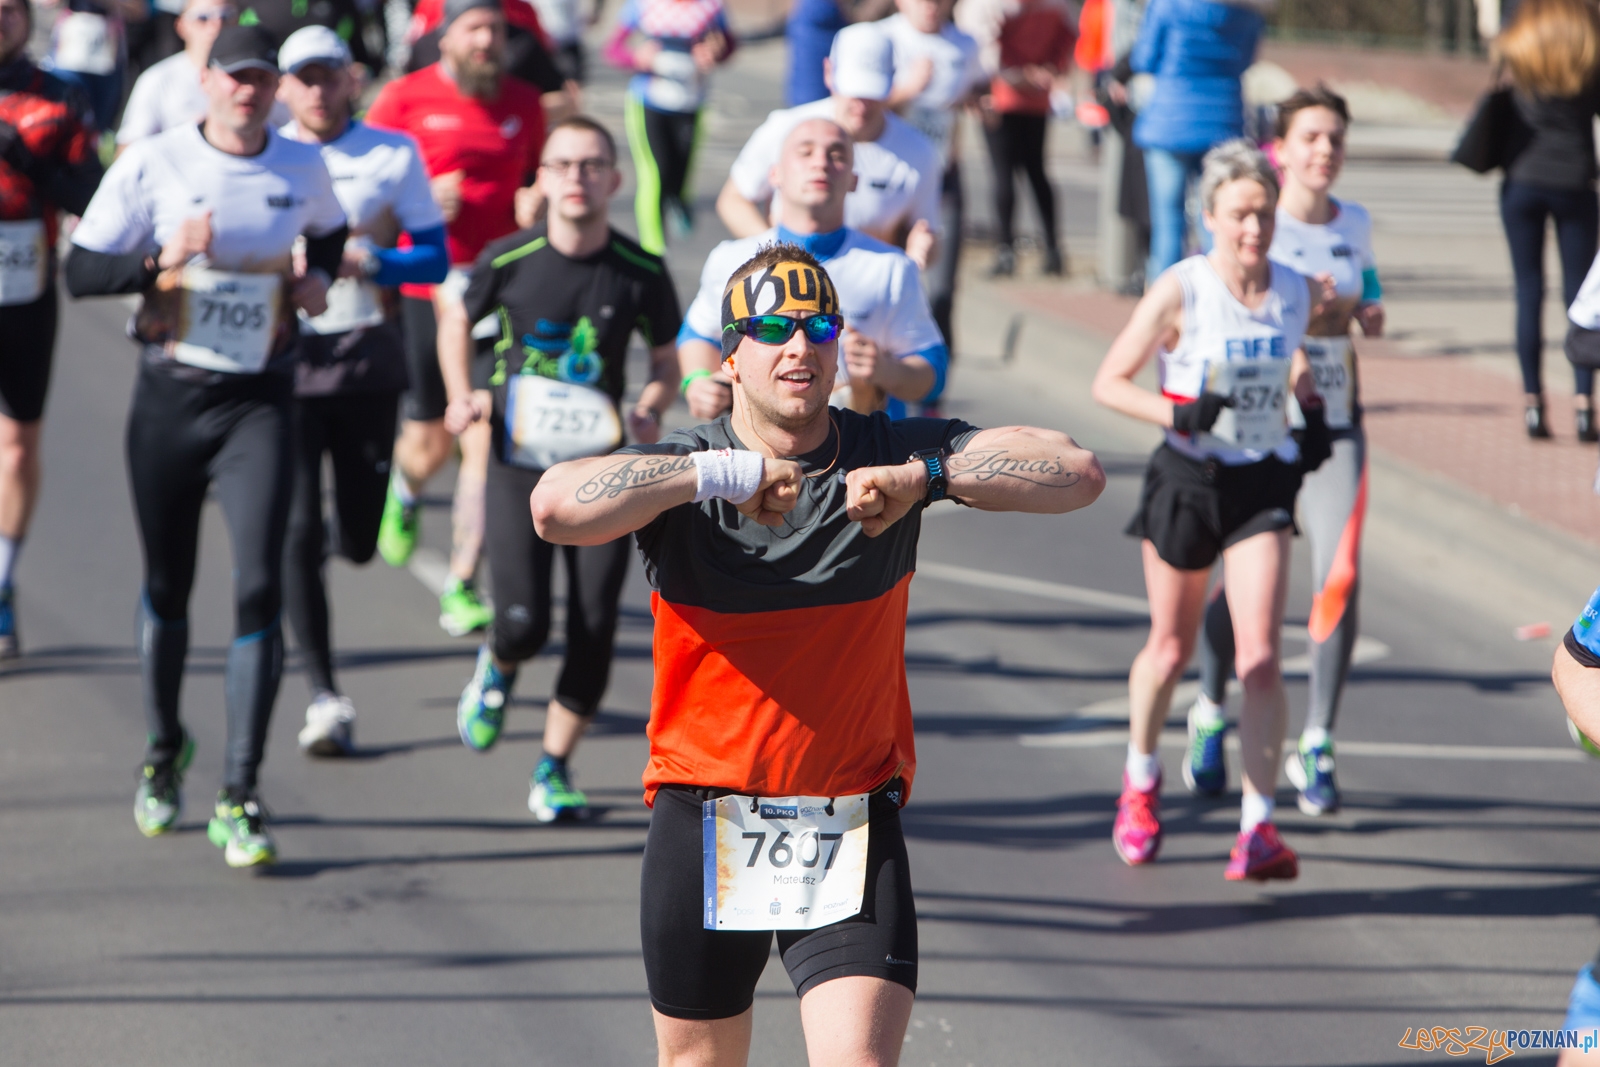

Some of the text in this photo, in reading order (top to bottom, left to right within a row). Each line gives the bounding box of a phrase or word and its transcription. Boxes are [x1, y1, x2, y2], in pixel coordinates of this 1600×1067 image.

[199, 300, 266, 329] 7105
[1226, 335, 1286, 359] FIFE
[535, 406, 602, 434] 7257
[764, 807, 775, 815] 10.
[776, 808, 795, 817] PKO
[741, 831, 844, 870] 7607
[773, 874, 816, 886] Mateusz
